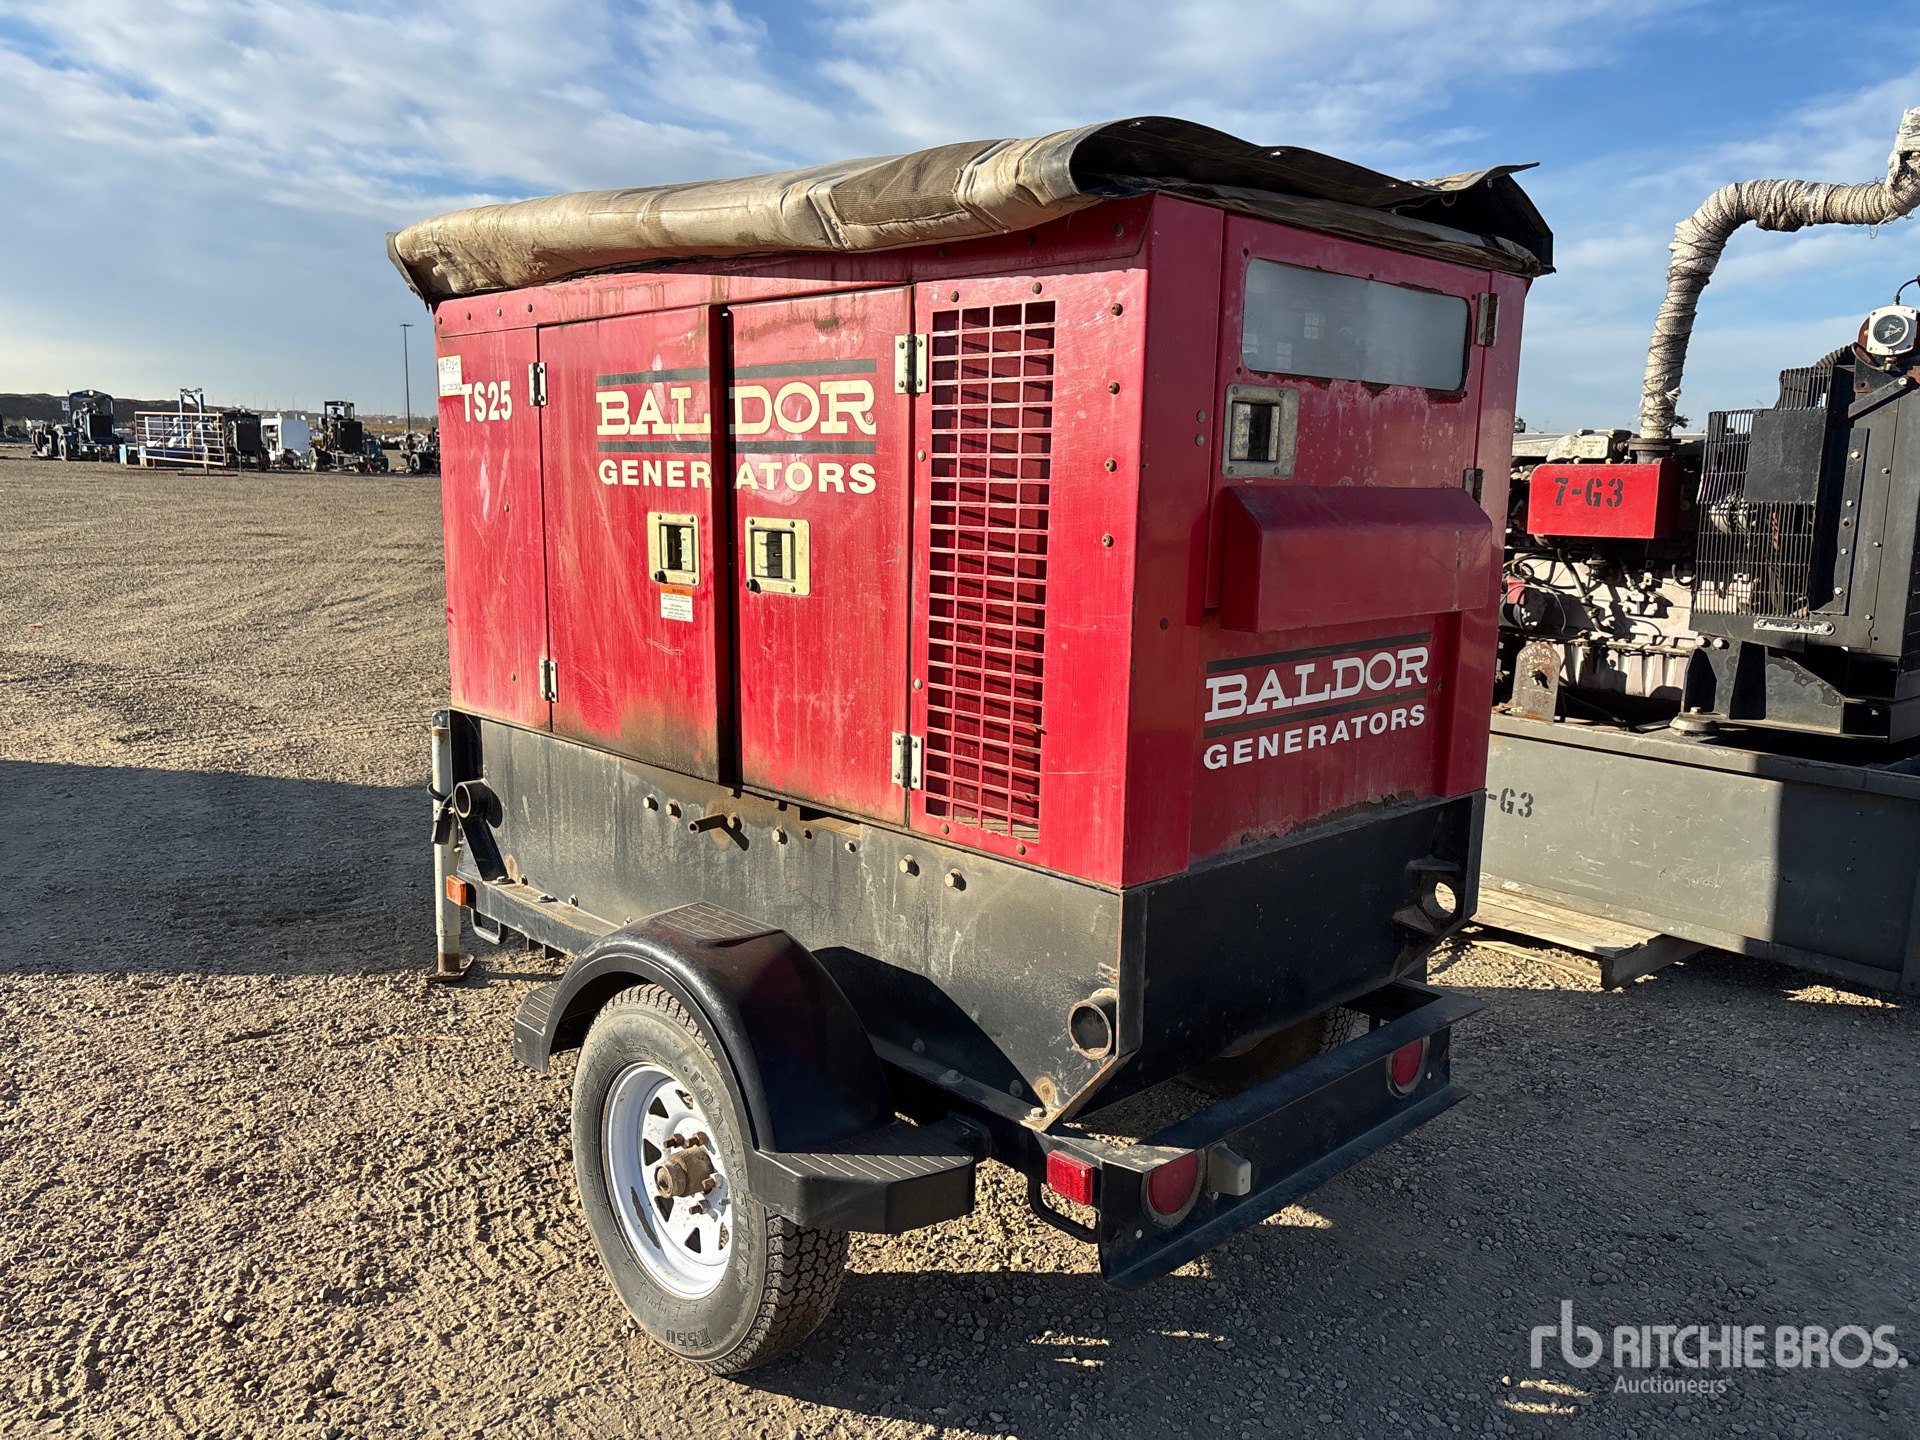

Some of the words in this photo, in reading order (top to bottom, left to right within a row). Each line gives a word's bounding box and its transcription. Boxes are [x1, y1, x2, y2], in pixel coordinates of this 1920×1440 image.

[461, 380, 512, 423] TS25
[596, 379, 877, 436] BALDOR
[598, 459, 877, 494] GENERATORS
[1554, 477, 1624, 508] 7-G3
[1204, 646, 1429, 722] BALDOR
[1203, 704, 1426, 770] GENERATORS
[1488, 787, 1535, 818] -G3
